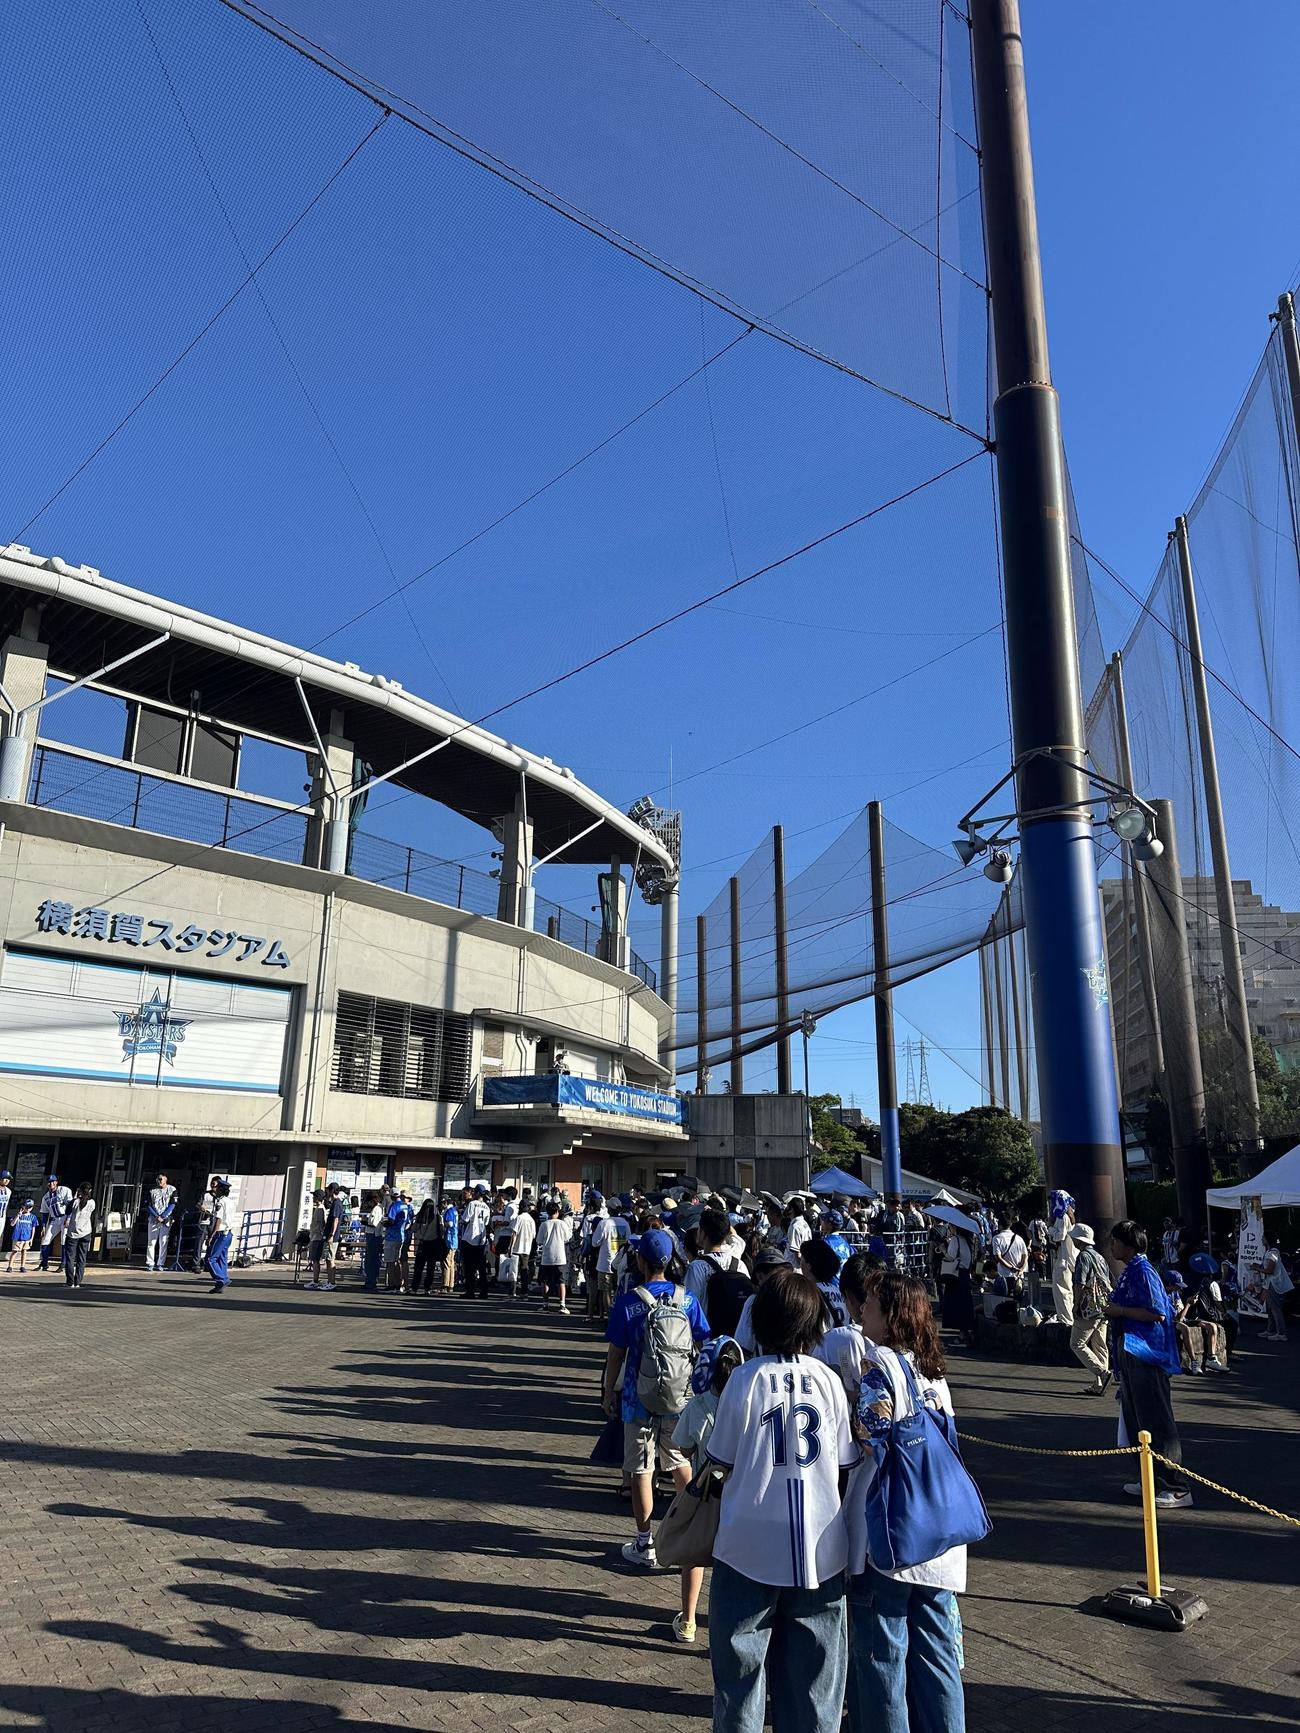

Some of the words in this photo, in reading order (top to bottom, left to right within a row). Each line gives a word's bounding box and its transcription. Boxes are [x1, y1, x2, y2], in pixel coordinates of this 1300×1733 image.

[36, 899, 291, 969] 横須賀スタジアム
[118, 1013, 186, 1042] BAYSTARS
[585, 1085, 618, 1105] WELCOME
[620, 1091, 628, 1106] TO
[629, 1093, 657, 1113] YOKOSUKA
[769, 1372, 812, 1395] ISE
[760, 1401, 822, 1468] 13
